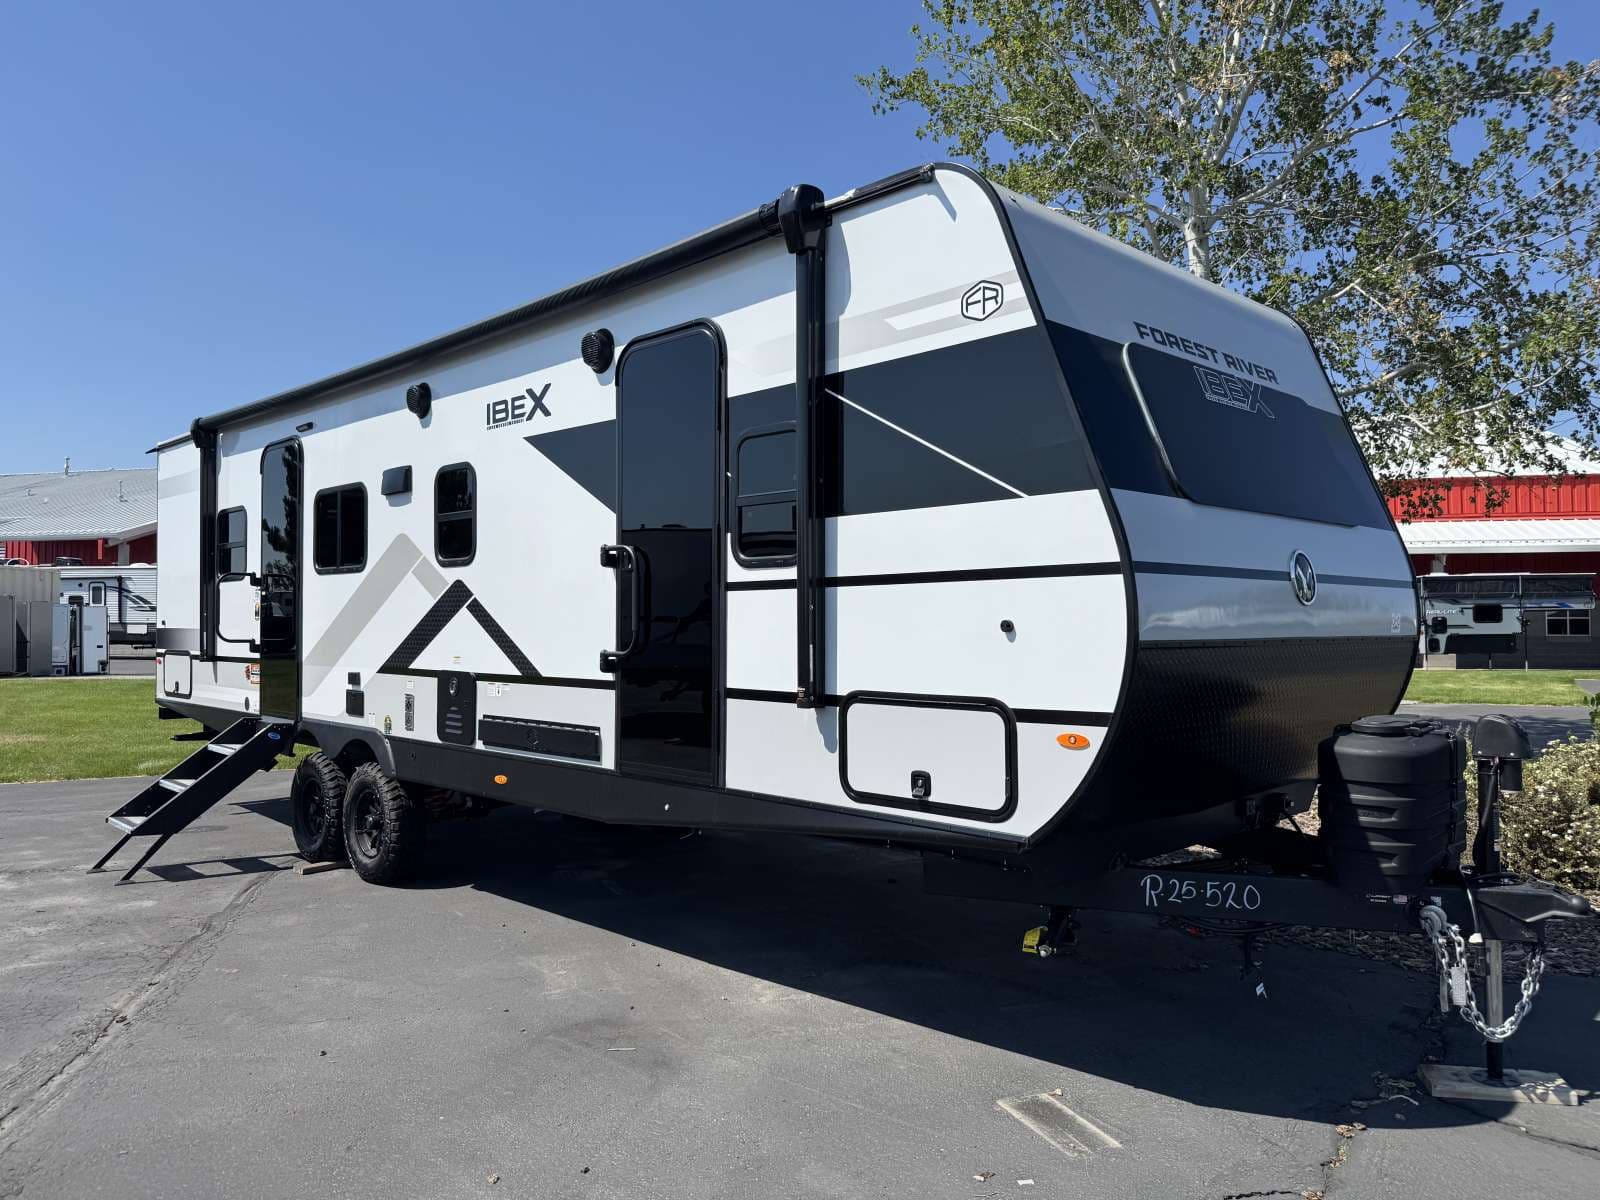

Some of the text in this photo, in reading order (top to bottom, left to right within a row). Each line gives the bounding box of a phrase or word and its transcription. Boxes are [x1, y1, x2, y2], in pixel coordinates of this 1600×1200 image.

[1133, 321, 1280, 385] FOREST RIVER
[486, 382, 552, 426] IBEX
[1193, 365, 1275, 419] IBEX
